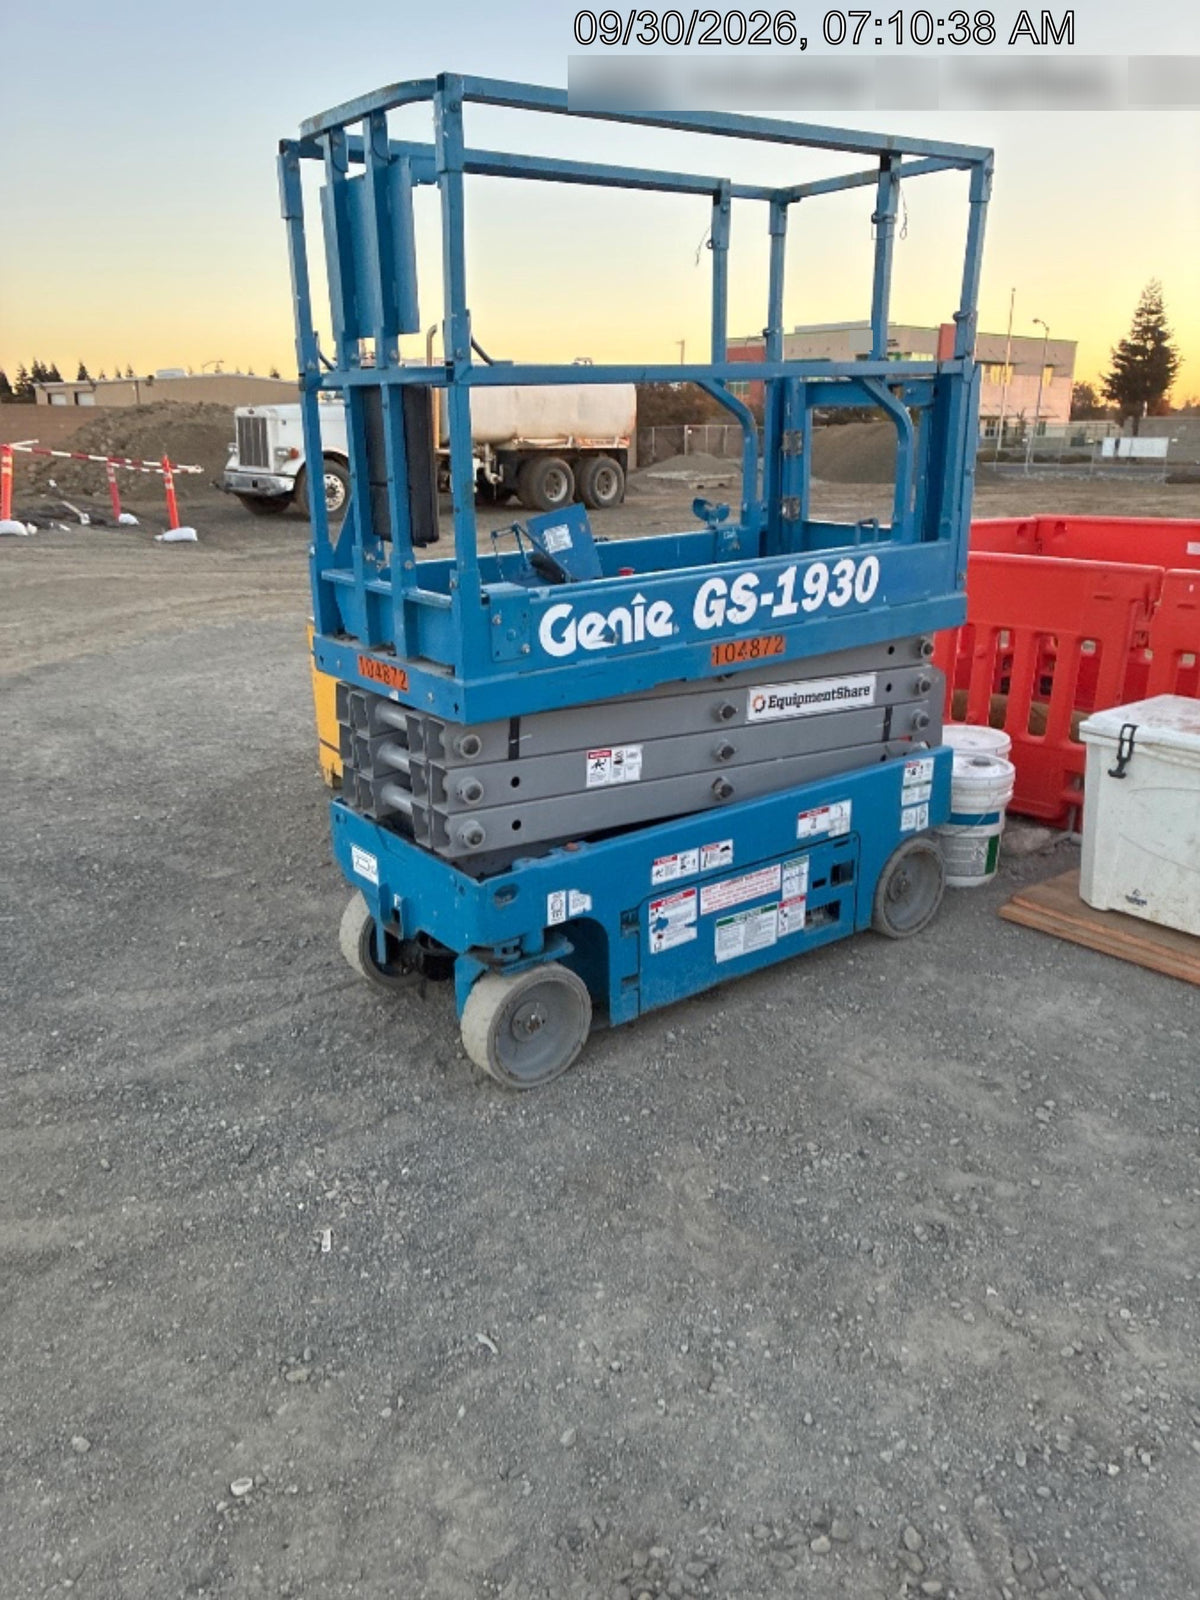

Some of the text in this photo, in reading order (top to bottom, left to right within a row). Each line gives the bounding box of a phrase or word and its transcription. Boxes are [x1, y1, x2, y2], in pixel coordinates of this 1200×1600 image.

[538, 556, 881, 657] Genie GS-1930
[712, 635, 783, 664] 104872
[358, 655, 408, 691] 104872
[767, 685, 870, 710] EquipmentShare
